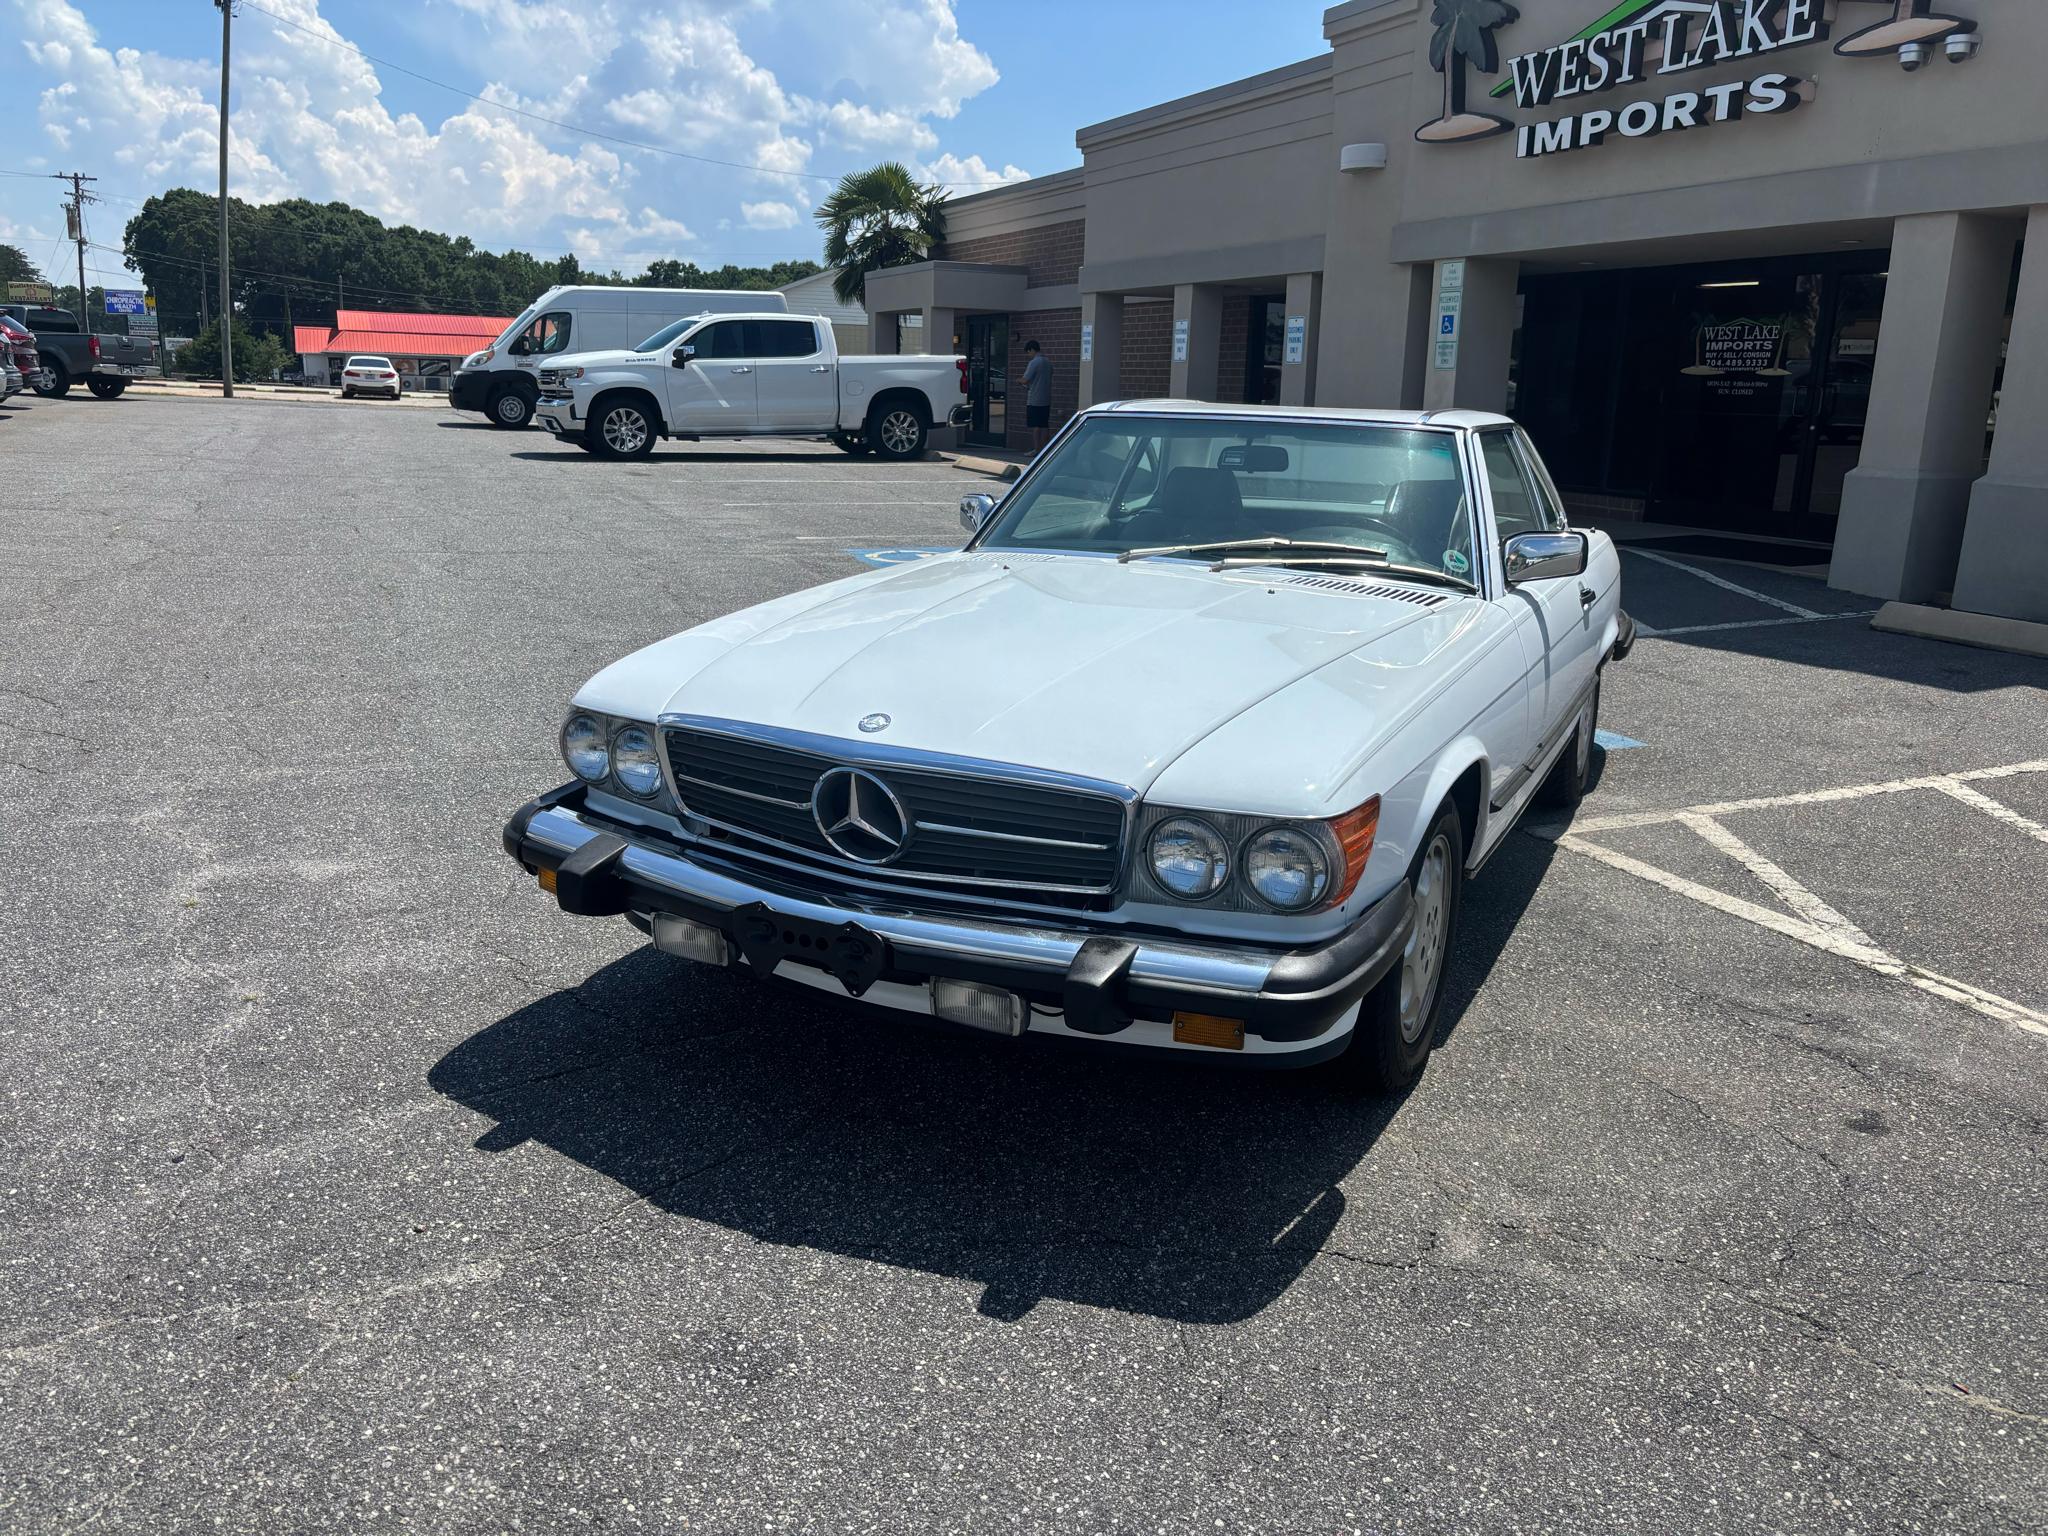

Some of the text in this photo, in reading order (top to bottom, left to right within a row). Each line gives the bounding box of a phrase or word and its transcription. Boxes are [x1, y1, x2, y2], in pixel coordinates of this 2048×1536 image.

[1507, 0, 1816, 108] WEST LAKE
[1516, 73, 1788, 158] IMPORTS
[106, 297, 144, 305] CHIROPRACTIC
[1704, 325, 1780, 340] WEST LAKE
[1706, 341, 1773, 350] IMPORTS
[1706, 359, 1768, 367] 704.489.9333
